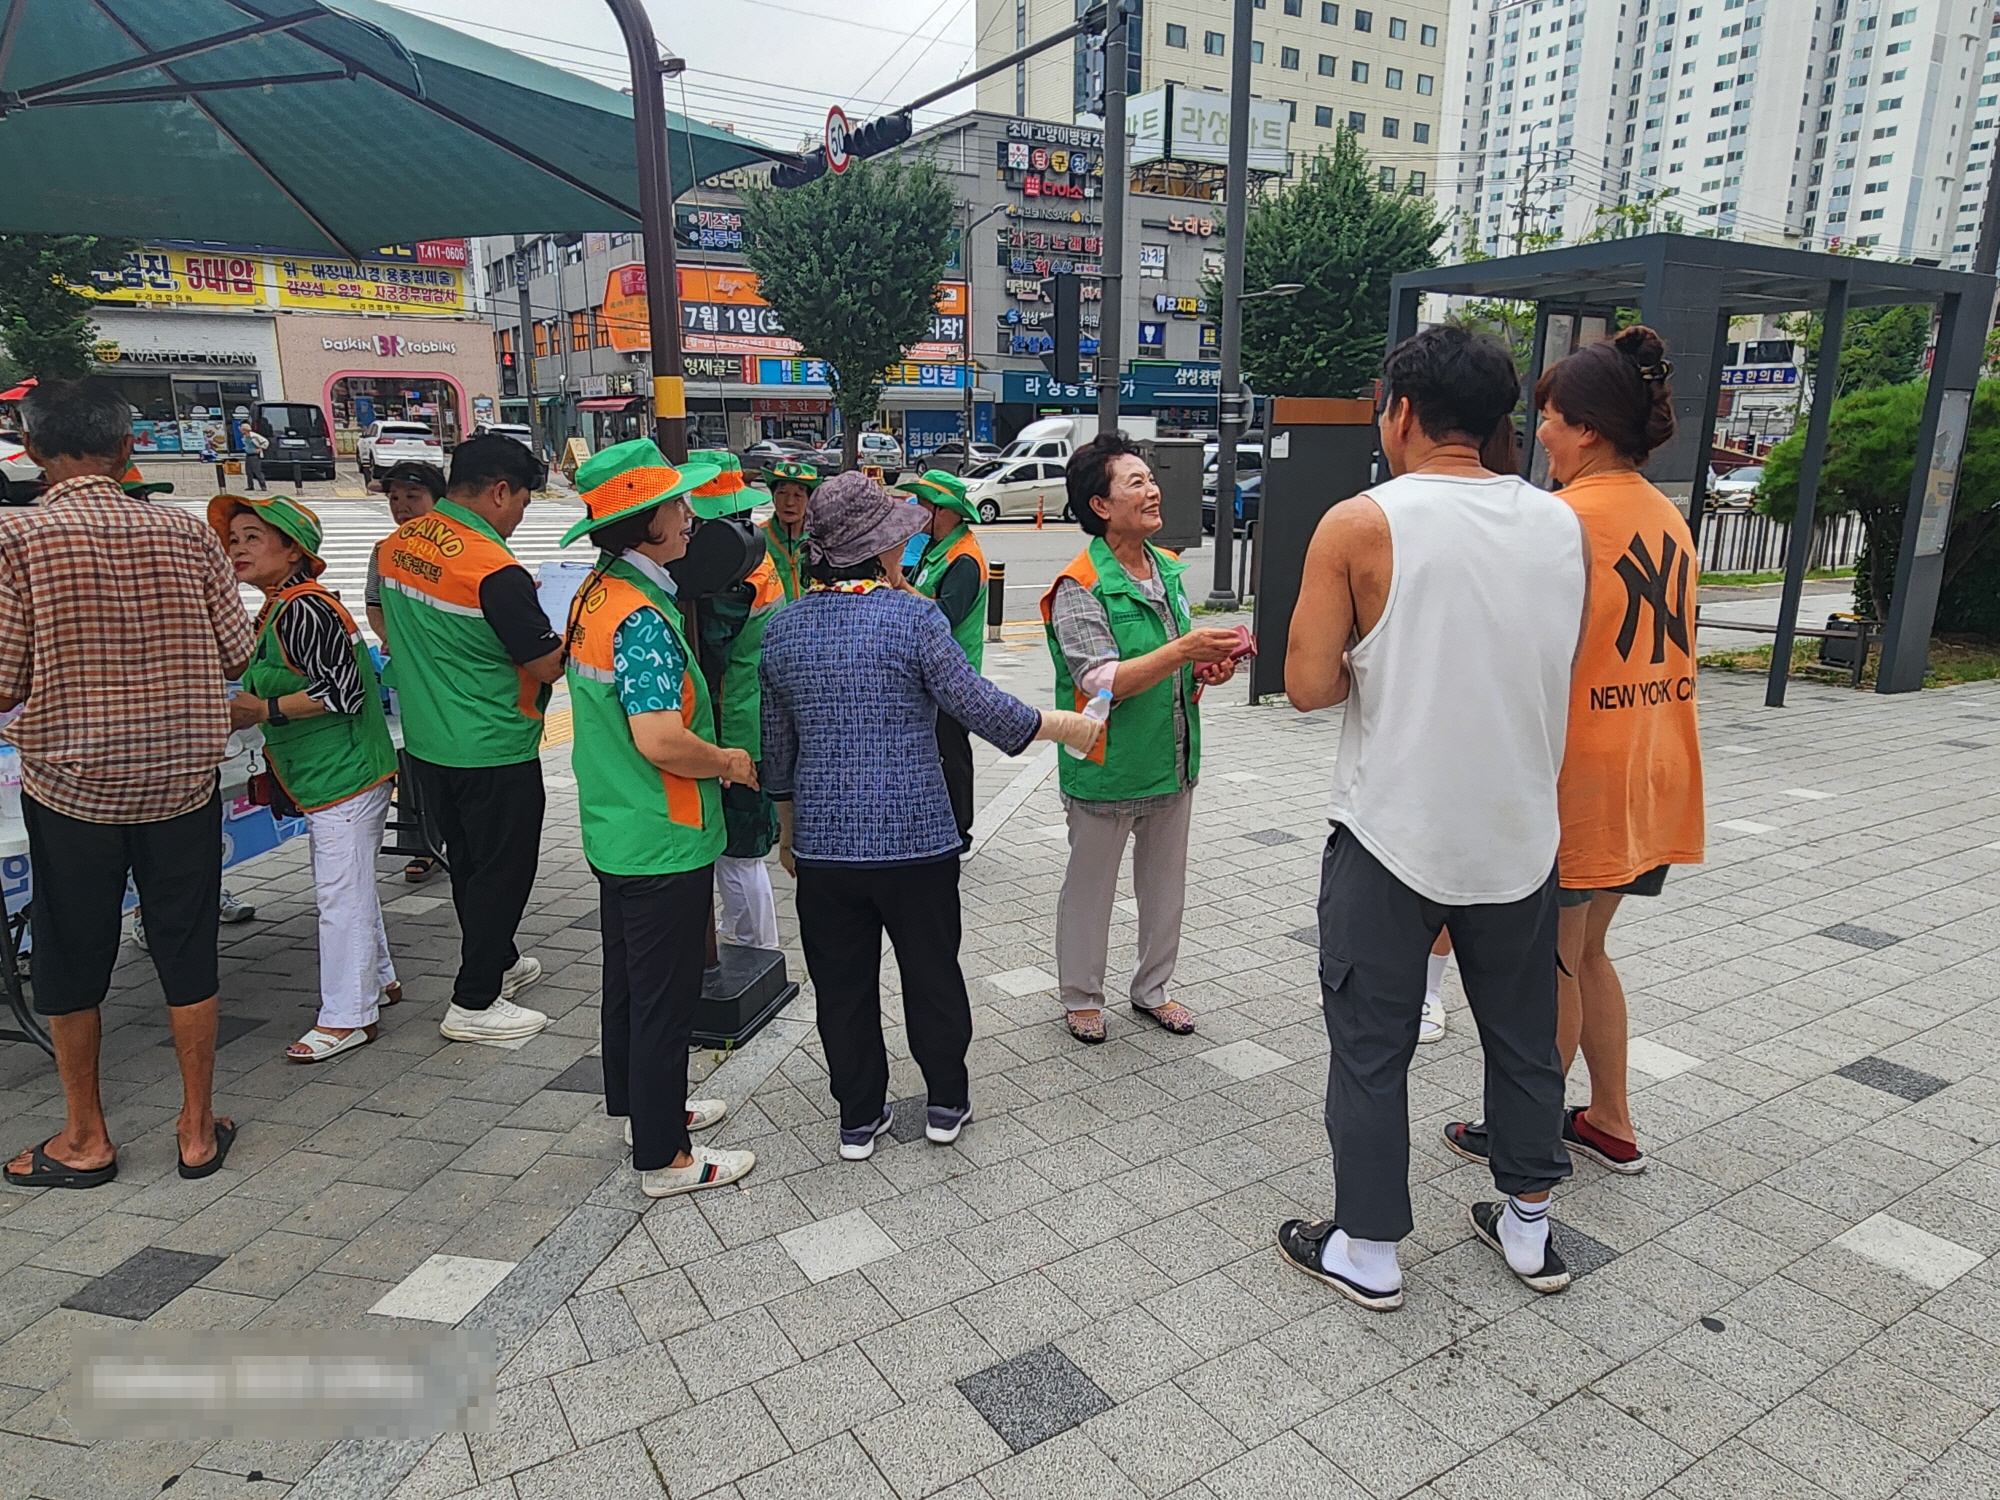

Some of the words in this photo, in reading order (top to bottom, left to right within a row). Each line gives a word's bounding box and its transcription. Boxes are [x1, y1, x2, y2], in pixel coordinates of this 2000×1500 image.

[831, 123, 845, 157] 50
[1042, 182, 1083, 199] 다이소
[700, 212, 741, 229] 키즈부
[1168, 214, 1213, 236] 노래방
[701, 232, 743, 248] 초등부
[418, 243, 465, 262] T.411-0606
[186, 257, 256, 293] 5대암
[283, 261, 298, 278] 위
[684, 305, 719, 331] 7월
[127, 349, 197, 364] WAFFLE
[205, 350, 255, 365] KHAN
[321, 337, 371, 350] baskin
[372, 335, 405, 357] BR
[407, 341, 457, 354] robbins
[684, 358, 741, 377] 형제골드
[406, 536, 440, 562] 안산시
[390, 549, 444, 584] 자율방재단
[1590, 683, 1637, 711] NEW
